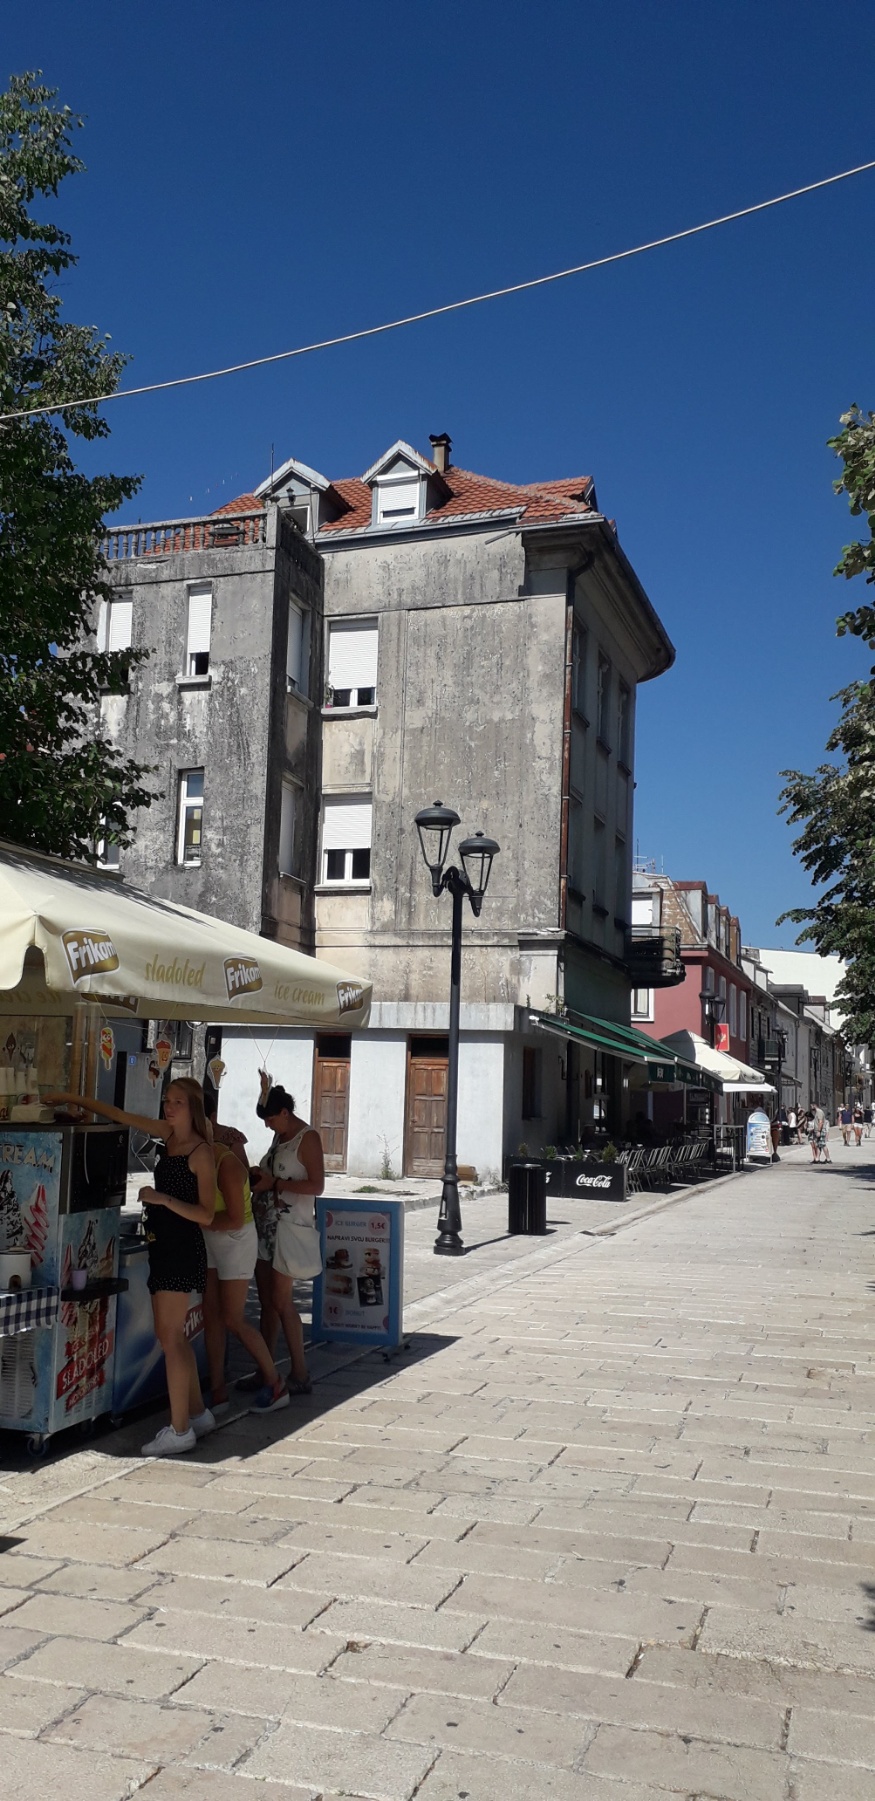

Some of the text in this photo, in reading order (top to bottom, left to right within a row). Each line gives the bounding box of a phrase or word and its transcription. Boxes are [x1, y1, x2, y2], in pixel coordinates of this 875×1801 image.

[144, 954, 206, 987] sladoled
[274, 980, 326, 1006] ice cream
[0, 1143, 56, 1173] REAM
[351, 1235, 365, 1243] SVOJ
[371, 1222, 385, 1230] 1,5€
[329, 1306, 338, 1315] 1€
[62, 1338, 109, 1390] SLADOLED
